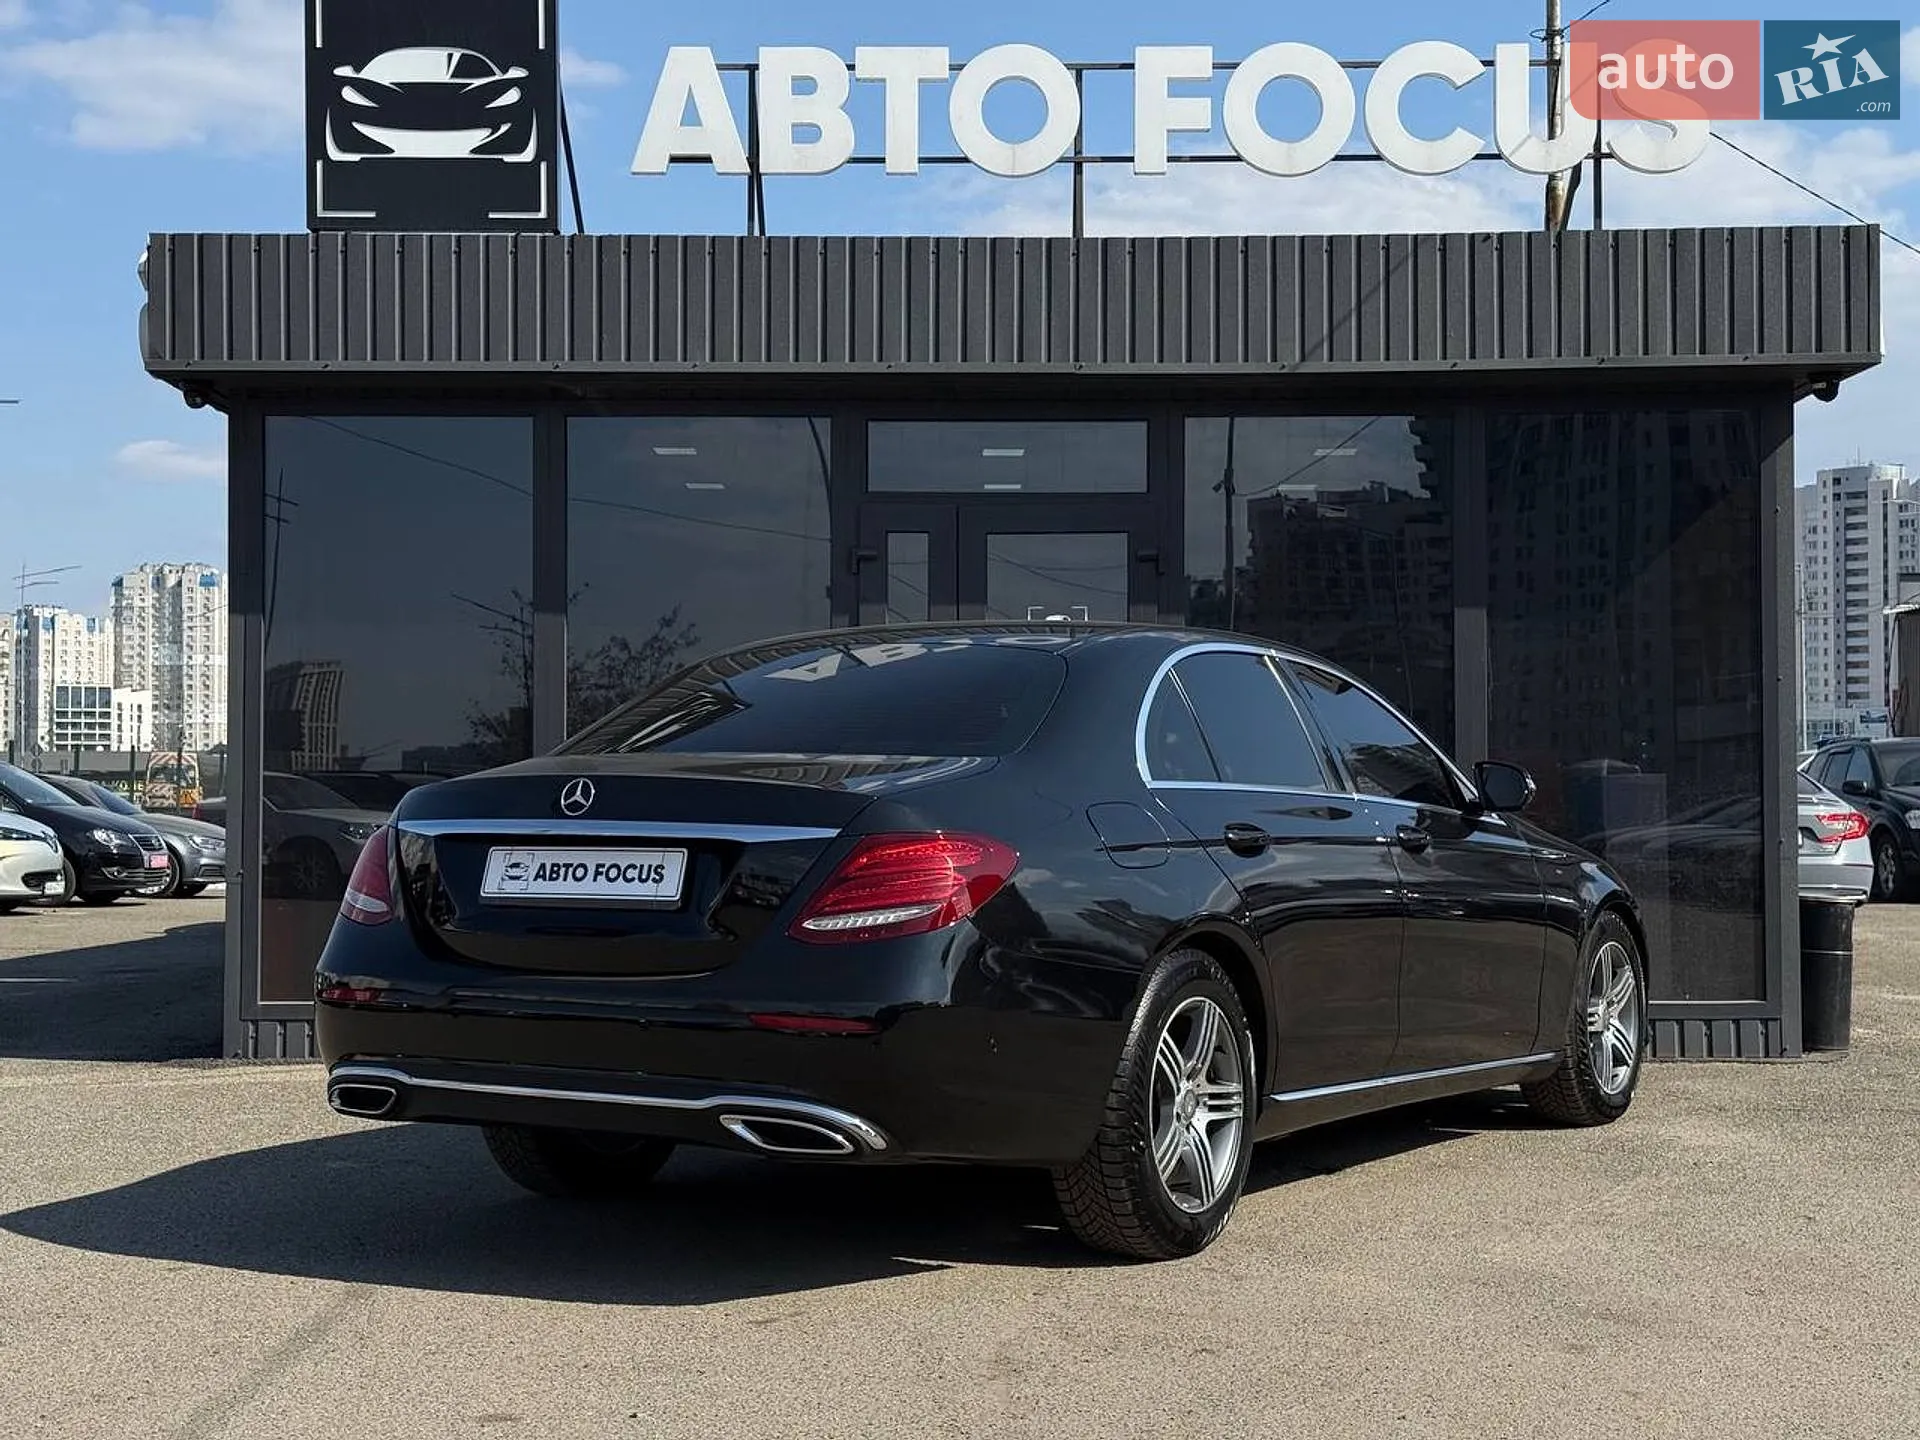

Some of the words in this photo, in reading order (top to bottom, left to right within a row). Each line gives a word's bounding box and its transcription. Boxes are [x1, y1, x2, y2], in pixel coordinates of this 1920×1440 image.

[631, 43, 1081, 177] АВТО
[1133, 38, 1711, 177] FOCUS
[532, 862, 588, 883] АВТО
[593, 862, 665, 884] FOCUS
